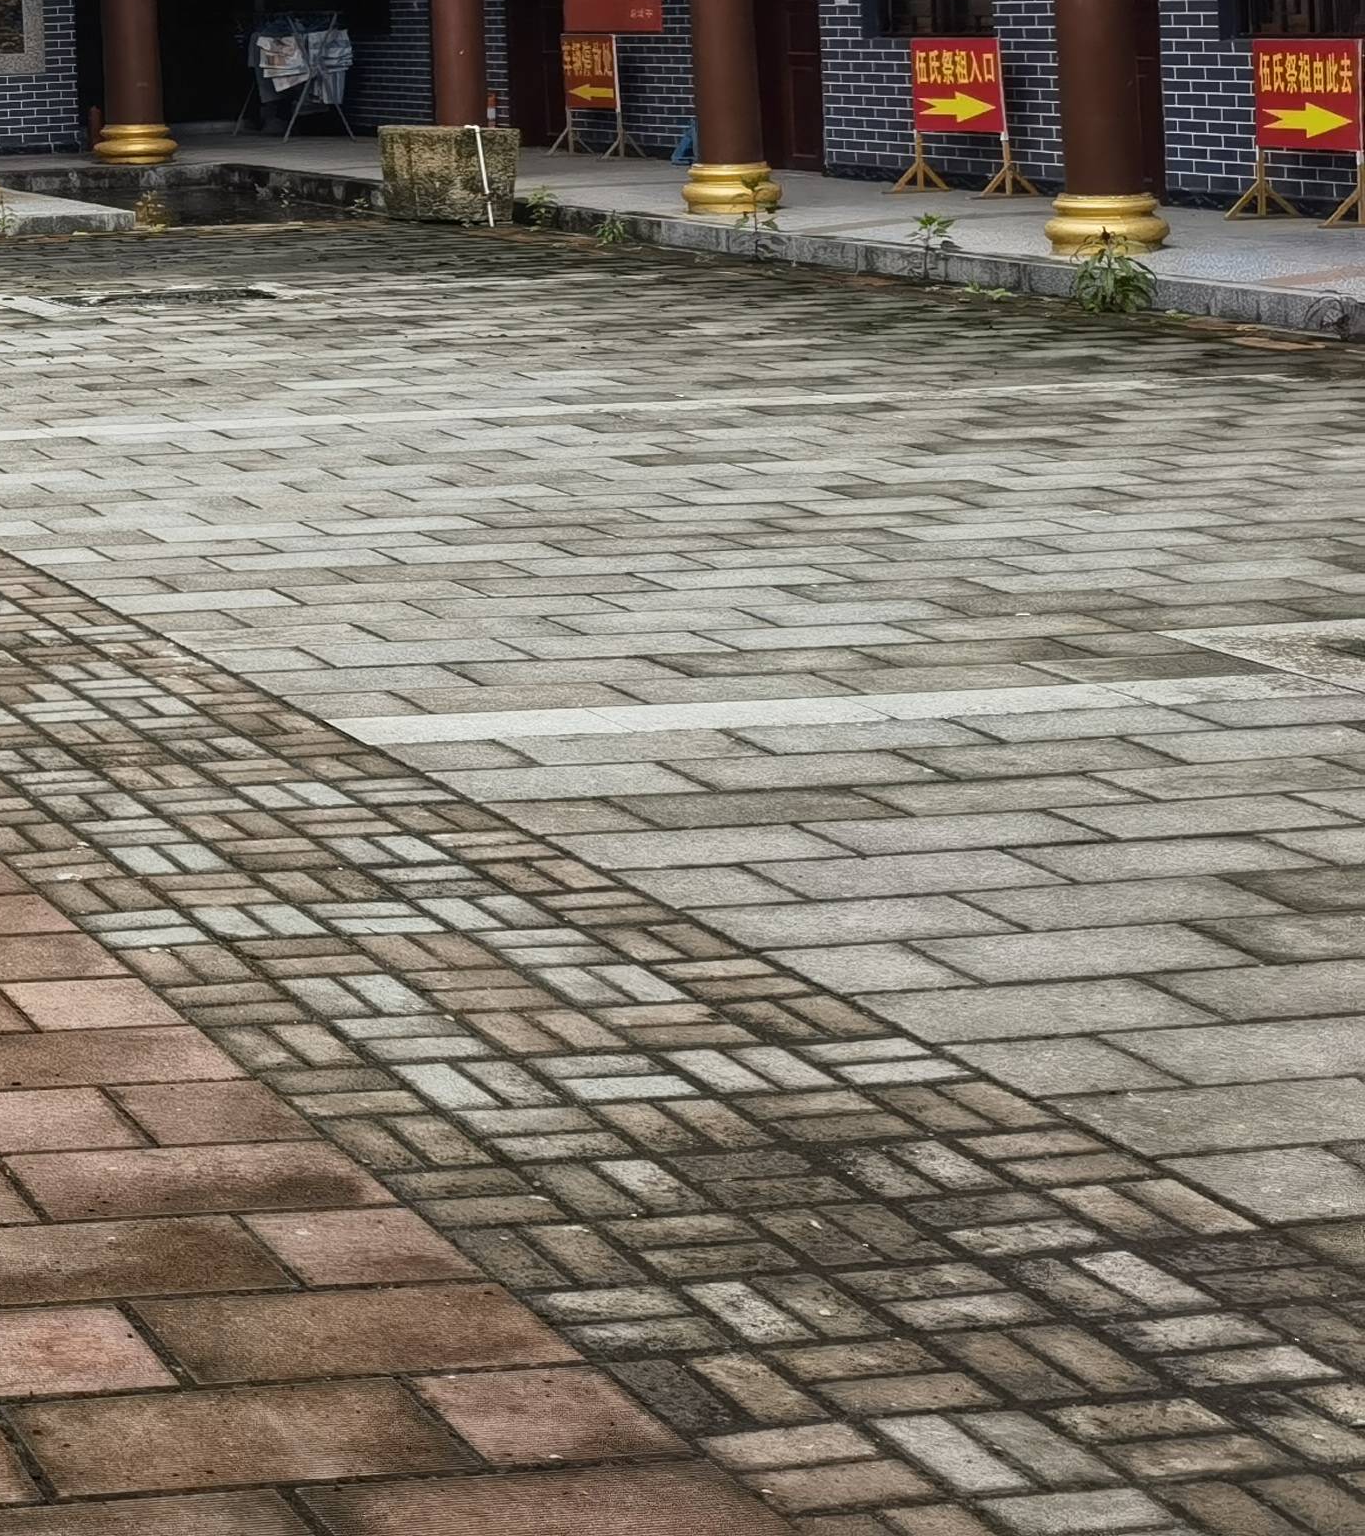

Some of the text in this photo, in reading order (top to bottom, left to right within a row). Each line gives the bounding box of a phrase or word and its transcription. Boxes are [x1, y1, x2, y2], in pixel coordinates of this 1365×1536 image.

[915, 49, 996, 84] 伍氏祭祖入口
[1259, 52, 1353, 94] 伍氏祭祖由此去
